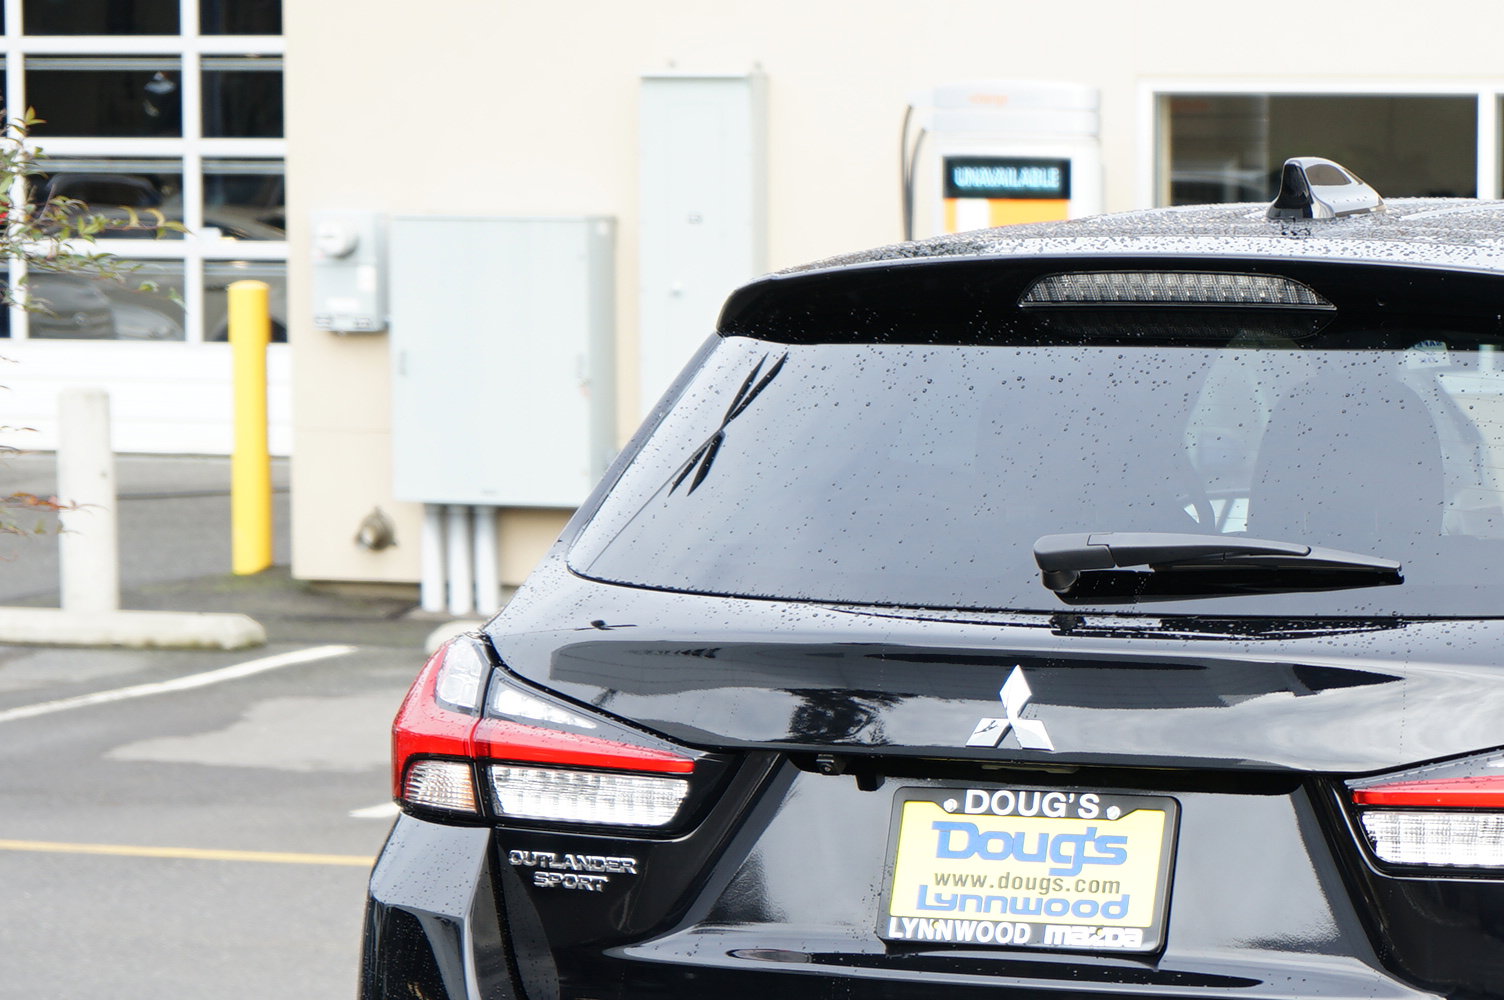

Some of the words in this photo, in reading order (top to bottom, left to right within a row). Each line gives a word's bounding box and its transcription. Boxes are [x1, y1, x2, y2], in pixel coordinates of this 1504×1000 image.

[953, 166, 1061, 189] UNAVAILABLE
[964, 789, 1101, 820] DOUG'S
[508, 849, 638, 875] OUTLANDER
[932, 821, 1129, 877] Doug's
[533, 871, 610, 893] SPORT
[934, 871, 1121, 895] www.dougs.com
[916, 884, 1131, 920] Lynnwood
[888, 916, 1032, 944] LYNNWOOD
